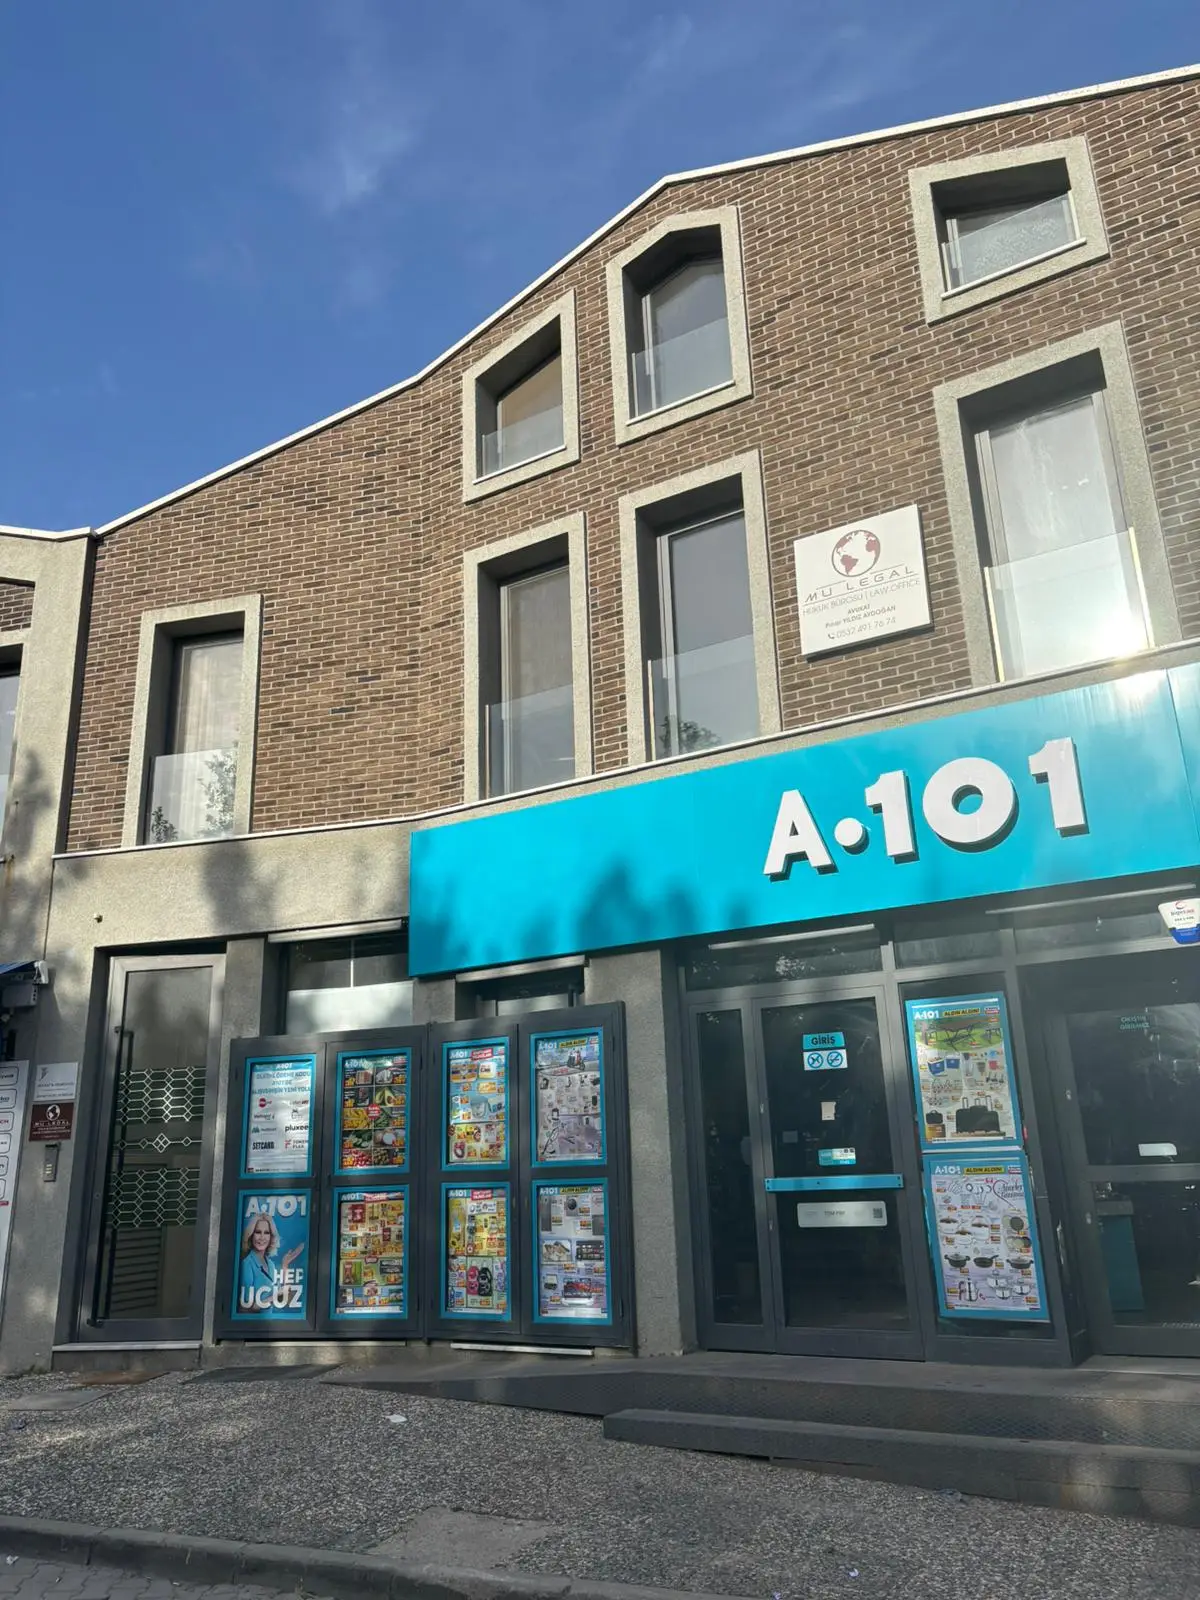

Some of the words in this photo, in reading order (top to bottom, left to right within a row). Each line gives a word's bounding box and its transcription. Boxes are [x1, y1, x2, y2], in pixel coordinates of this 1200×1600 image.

[804, 587, 832, 603] MU
[846, 566, 914, 591] LEGAL
[252, 1141, 275, 1150] SETCARD
[240, 1285, 303, 1309] UCUZ
